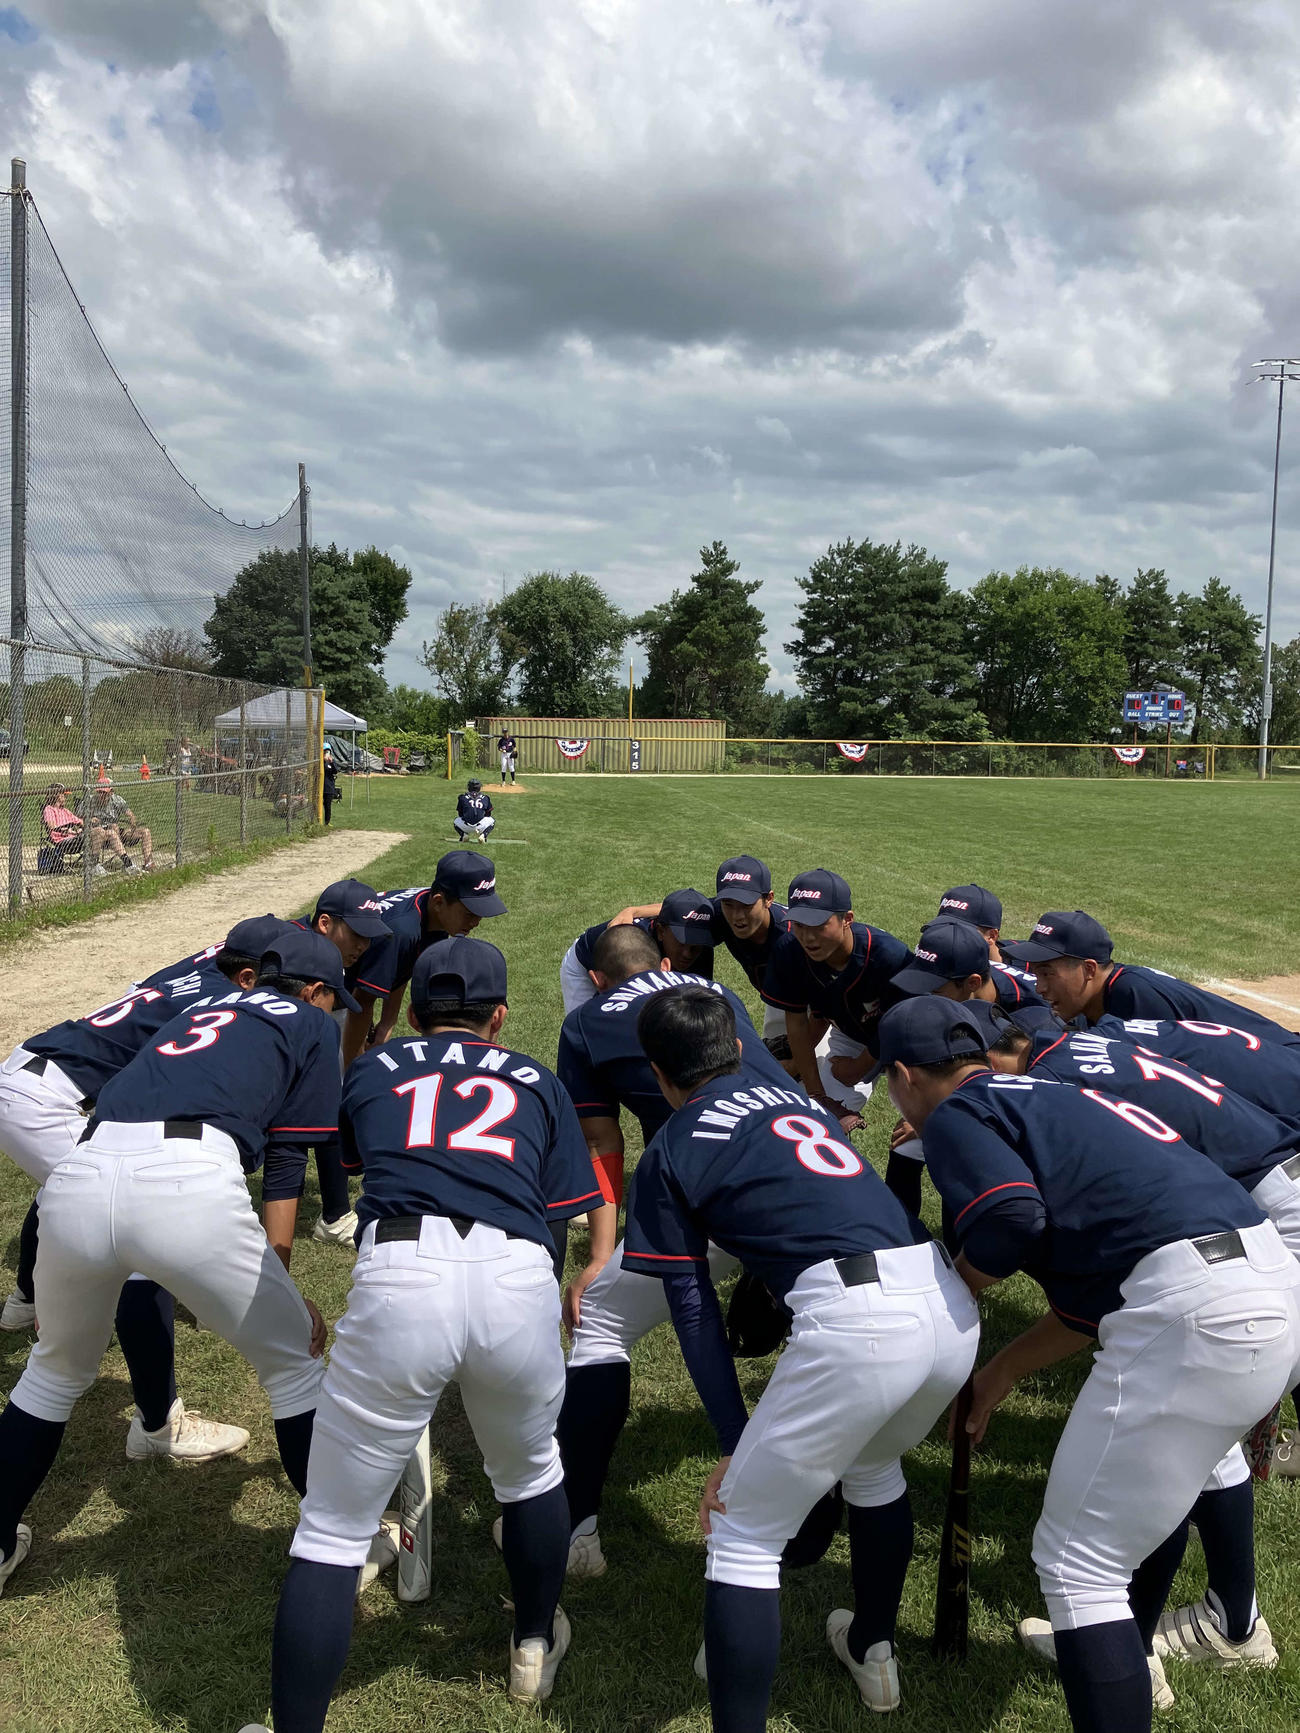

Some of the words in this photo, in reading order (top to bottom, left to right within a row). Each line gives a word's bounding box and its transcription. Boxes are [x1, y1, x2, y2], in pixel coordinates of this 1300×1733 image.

[474, 878, 495, 890] Jap
[721, 871, 751, 882] Japan
[790, 887, 821, 900] Japan
[358, 900, 381, 911] Jap
[682, 910, 710, 921] Japan
[156, 1010, 237, 1055] 3
[1176, 1020, 1261, 1051] 9
[376, 1041, 540, 1084] ITANO
[392, 1072, 518, 1162] 12
[691, 1086, 827, 1140] INOSHITA
[1080, 1088, 1181, 1143] 6
[771, 1114, 863, 1177] 8
